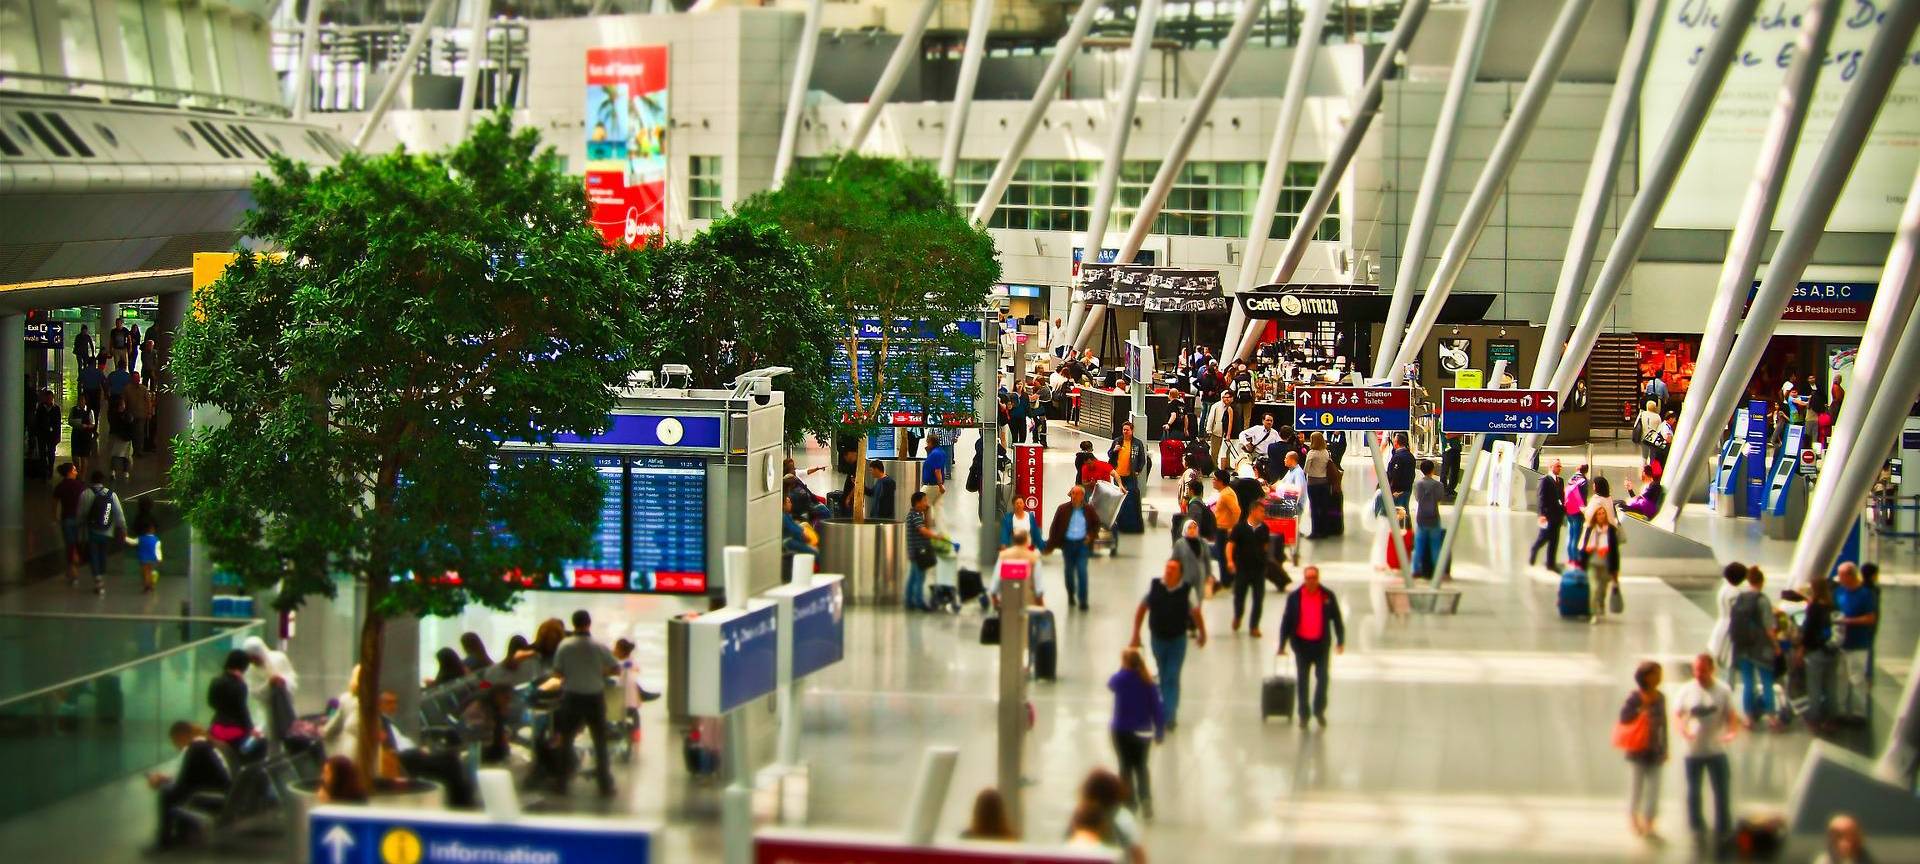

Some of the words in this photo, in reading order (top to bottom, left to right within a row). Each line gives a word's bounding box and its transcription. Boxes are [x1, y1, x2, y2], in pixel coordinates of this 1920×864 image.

[1246, 297, 1281, 312] Caffè
[1300, 298, 1339, 314] RITAZZA
[1795, 305, 1803, 313] &
[1804, 305, 1857, 314] Restaurants
[1364, 390, 1392, 398] Toiletten
[1450, 396, 1471, 404] Shops
[1478, 396, 1518, 404] Restaurants
[1336, 415, 1380, 423] Information
[1488, 421, 1517, 429] Customs
